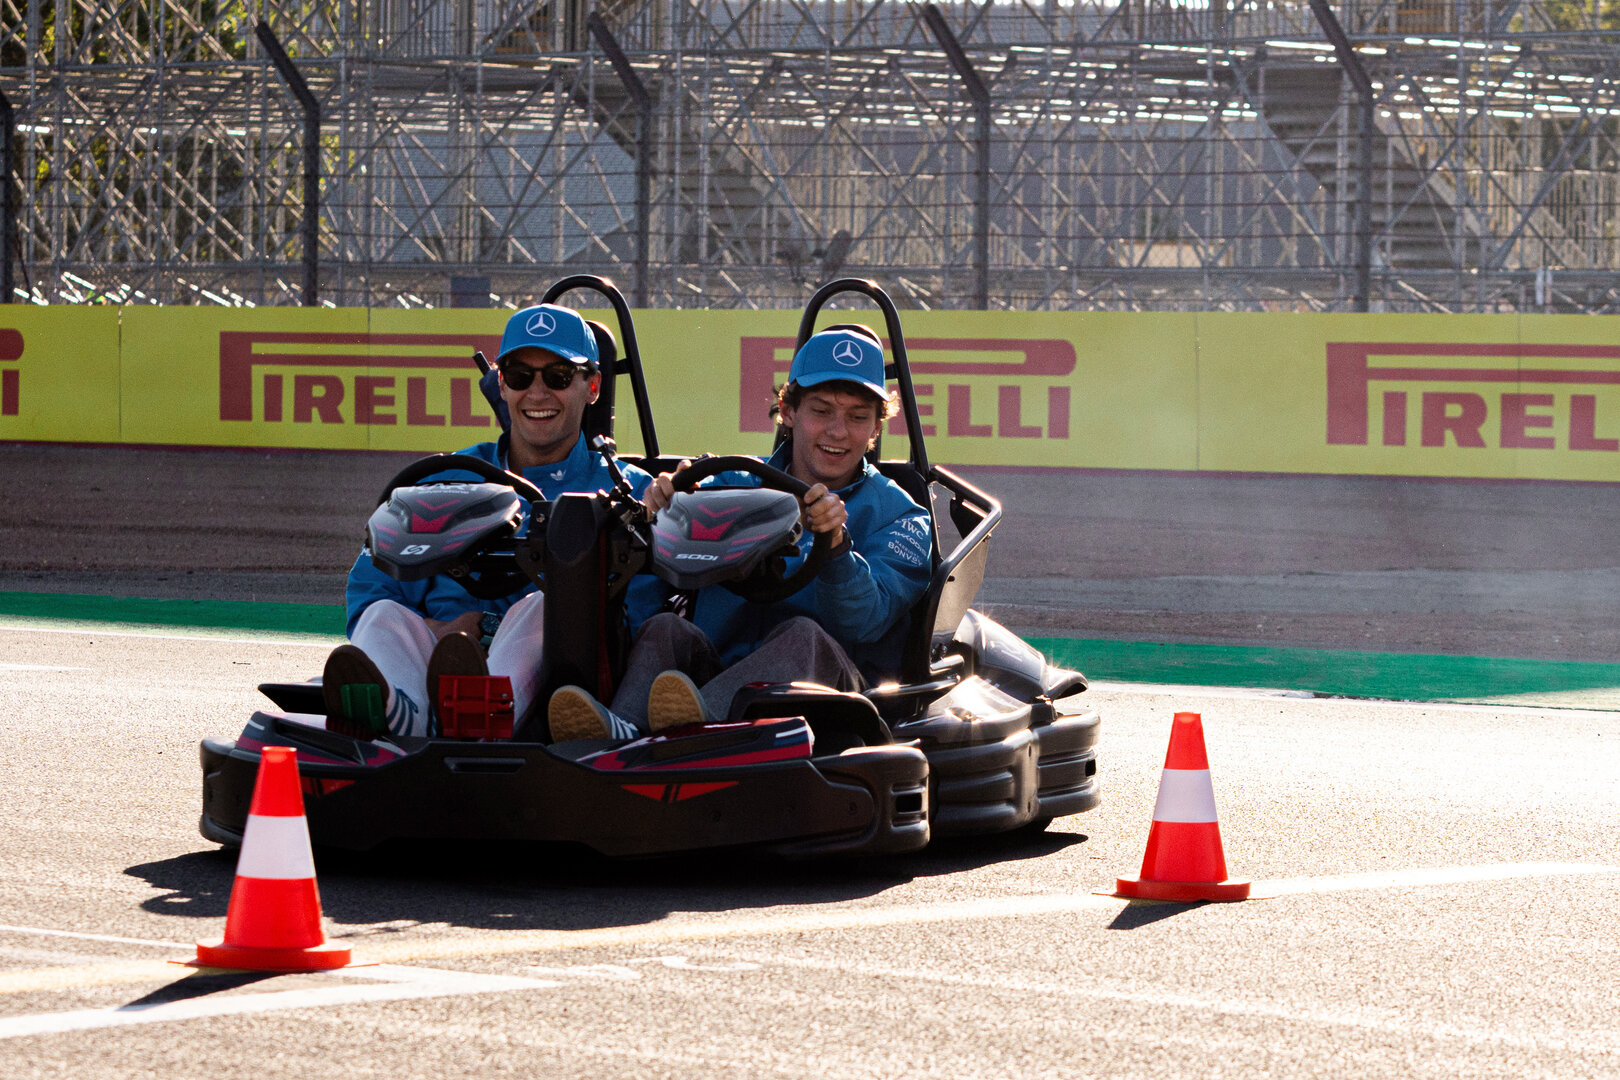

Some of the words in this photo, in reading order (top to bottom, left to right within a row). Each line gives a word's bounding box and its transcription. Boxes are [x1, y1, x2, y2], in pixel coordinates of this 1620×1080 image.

[219, 331, 503, 427] PIRELL
[739, 337, 1077, 439] PELLI
[1326, 342, 1620, 451] PIREL
[675, 553, 719, 561] SODI
[887, 541, 923, 566] BONVOY
